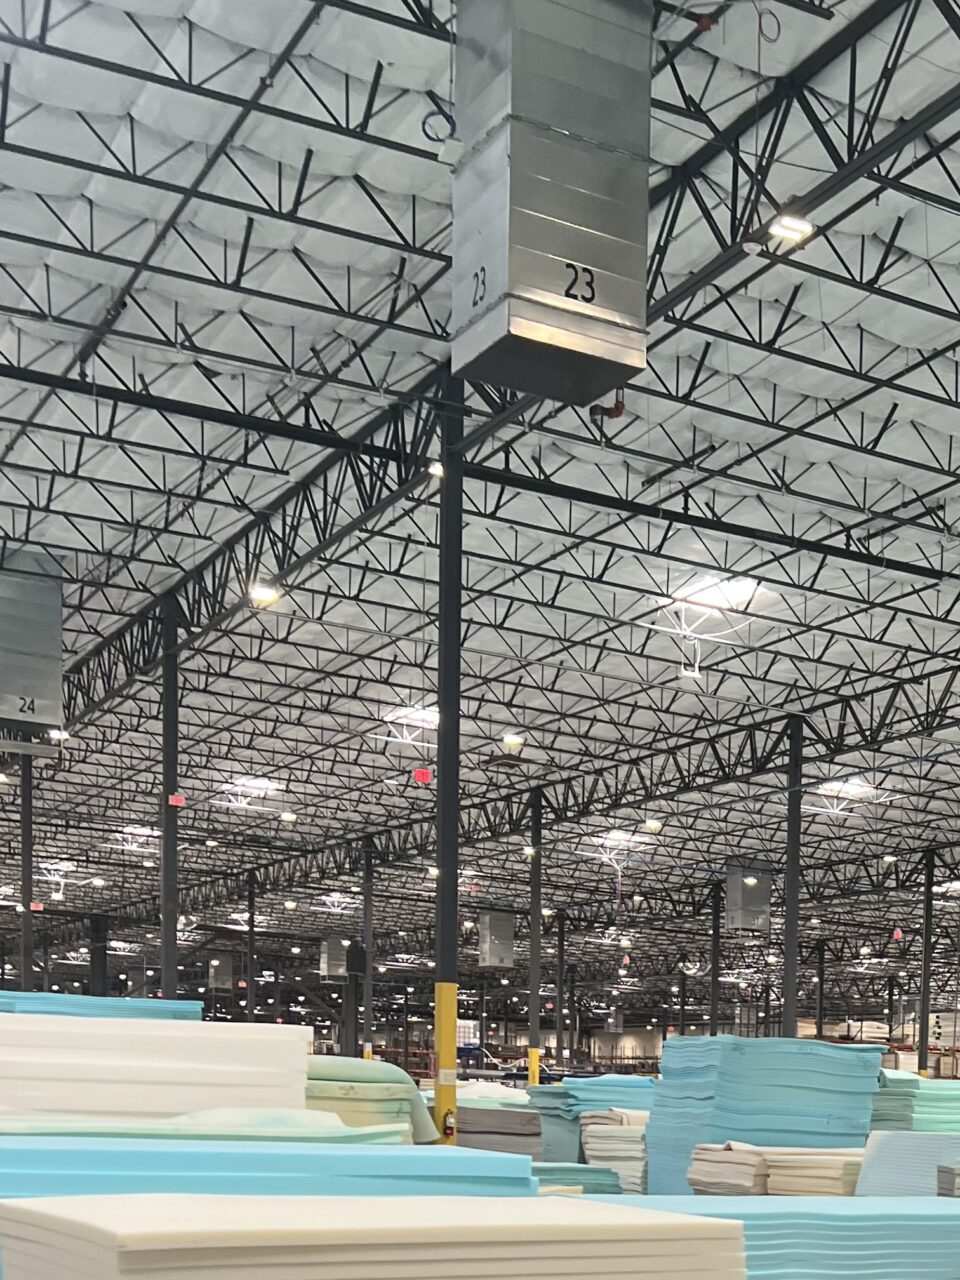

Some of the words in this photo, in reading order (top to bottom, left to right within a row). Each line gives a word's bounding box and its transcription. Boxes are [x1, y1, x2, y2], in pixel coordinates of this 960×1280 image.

[472, 266, 486, 307] 23
[564, 262, 596, 303] 23
[18, 696, 35, 715] 24
